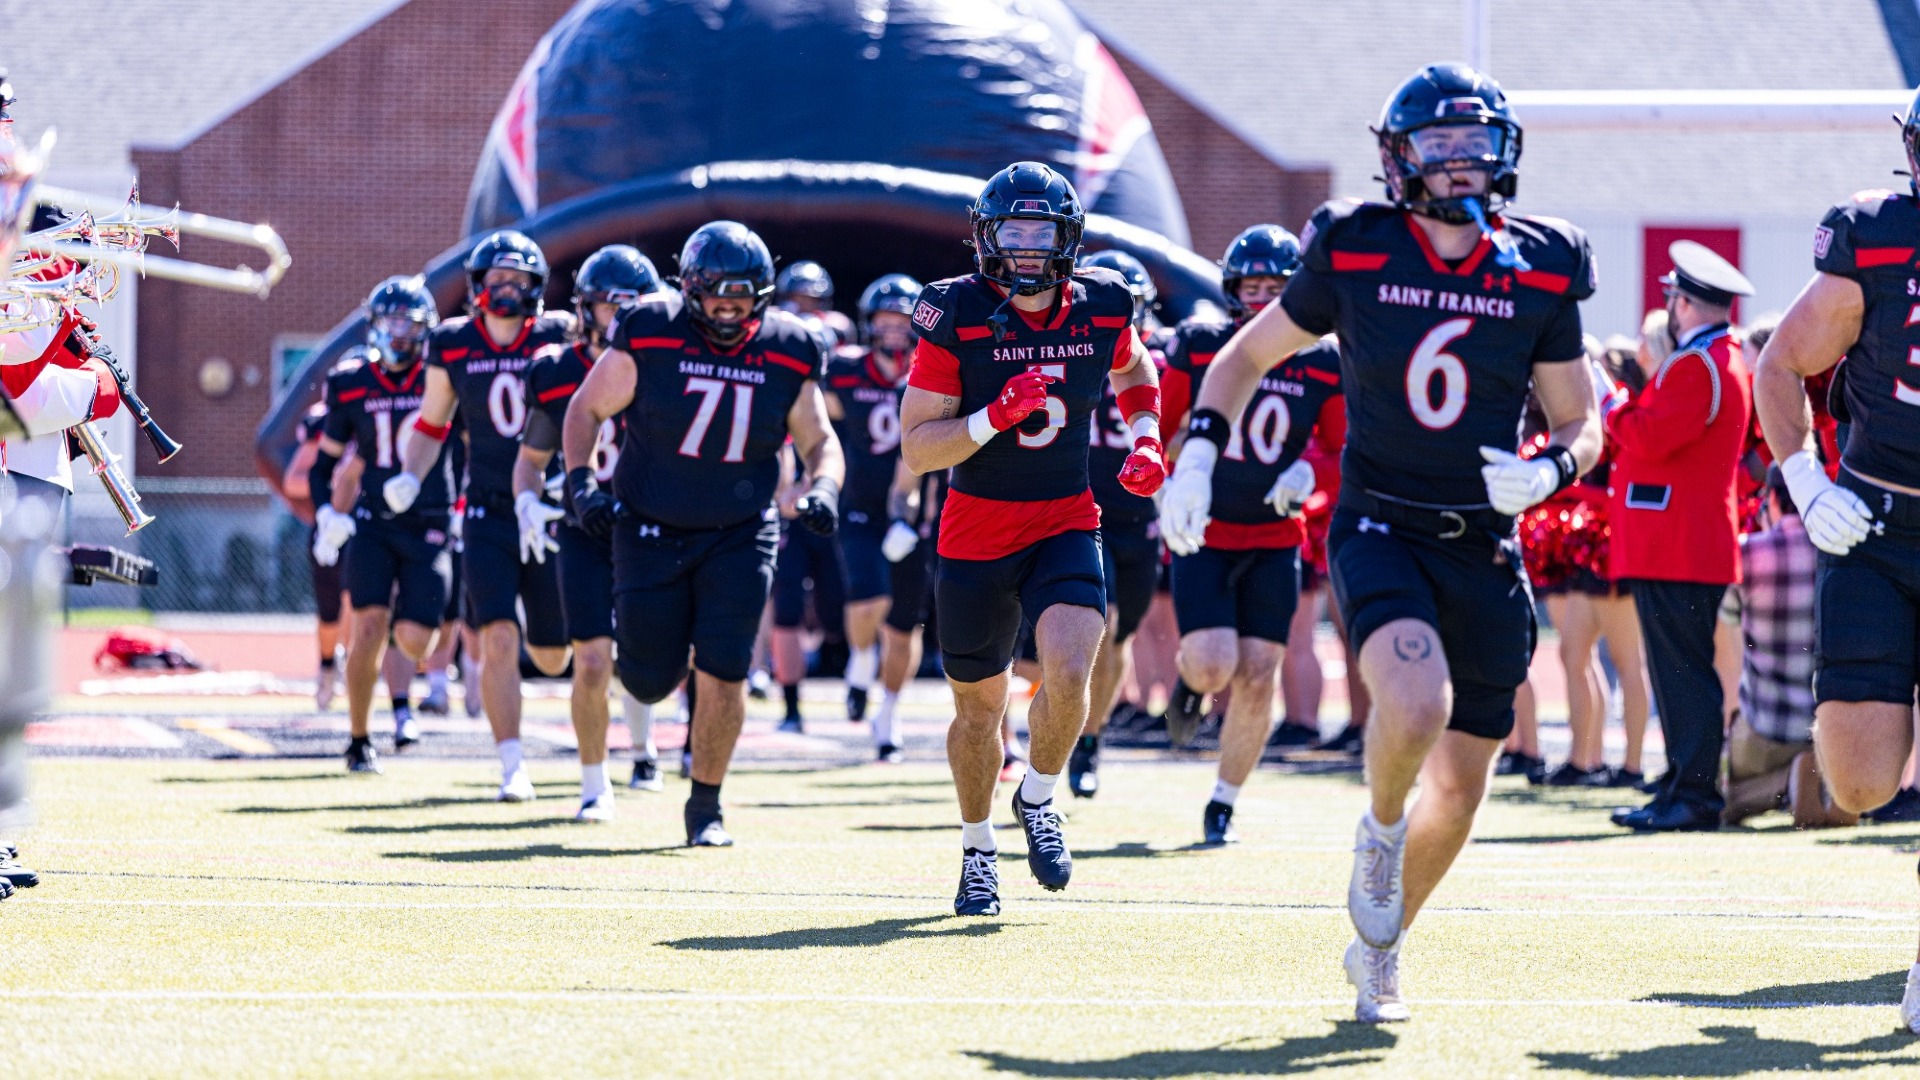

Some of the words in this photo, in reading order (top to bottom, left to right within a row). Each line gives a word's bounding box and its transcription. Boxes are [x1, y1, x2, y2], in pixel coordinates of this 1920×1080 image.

[914, 302, 942, 329] SFU
[1378, 283, 1433, 308] SAINT
[1438, 291, 1515, 319] FRANCIS
[993, 347, 1034, 361] SAINT
[1040, 343, 1094, 359] FRANCIS
[678, 360, 715, 376] SAINT
[717, 365, 766, 384] FRANCIS
[1403, 315, 1476, 431] 6
[677, 376, 754, 463] 71
[1016, 361, 1069, 450] 5
